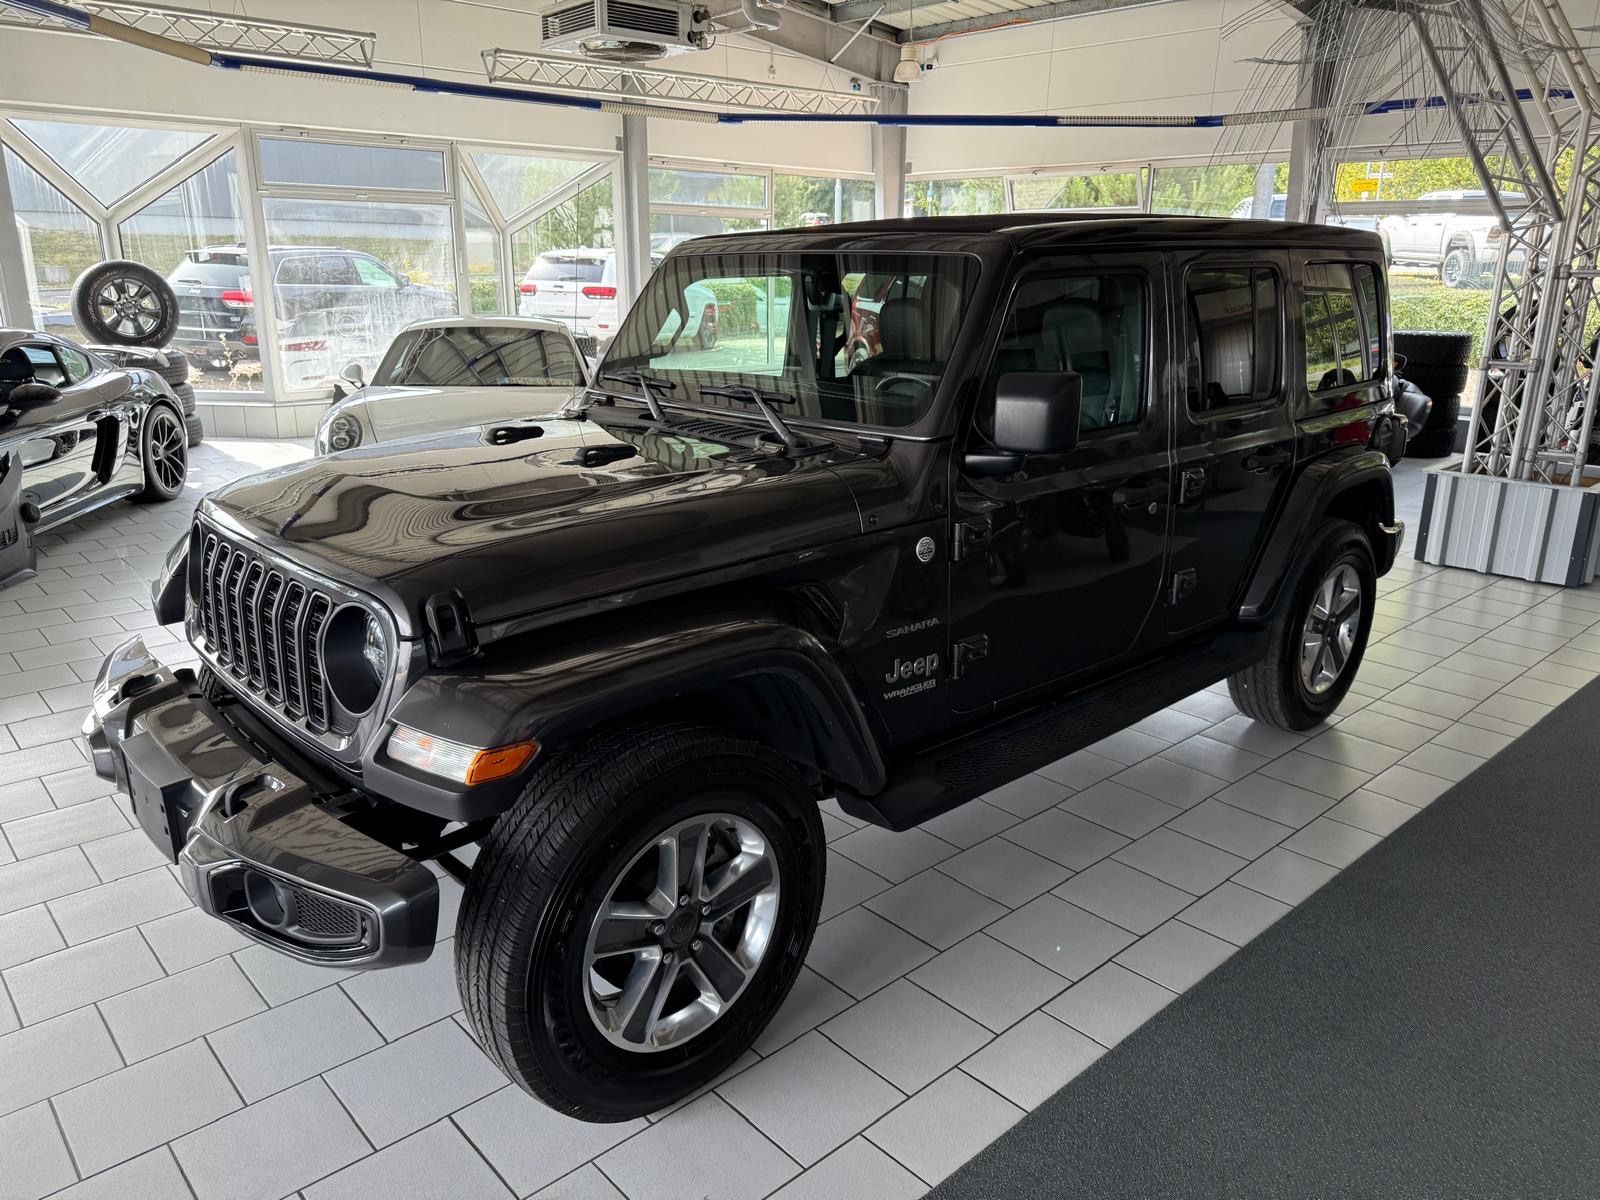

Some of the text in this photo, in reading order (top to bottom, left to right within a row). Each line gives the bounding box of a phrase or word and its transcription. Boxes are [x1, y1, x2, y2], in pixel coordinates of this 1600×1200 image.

[886, 617, 940, 639] SAHARA
[885, 653, 940, 683] Jeep
[883, 678, 936, 700] WRANGLER
